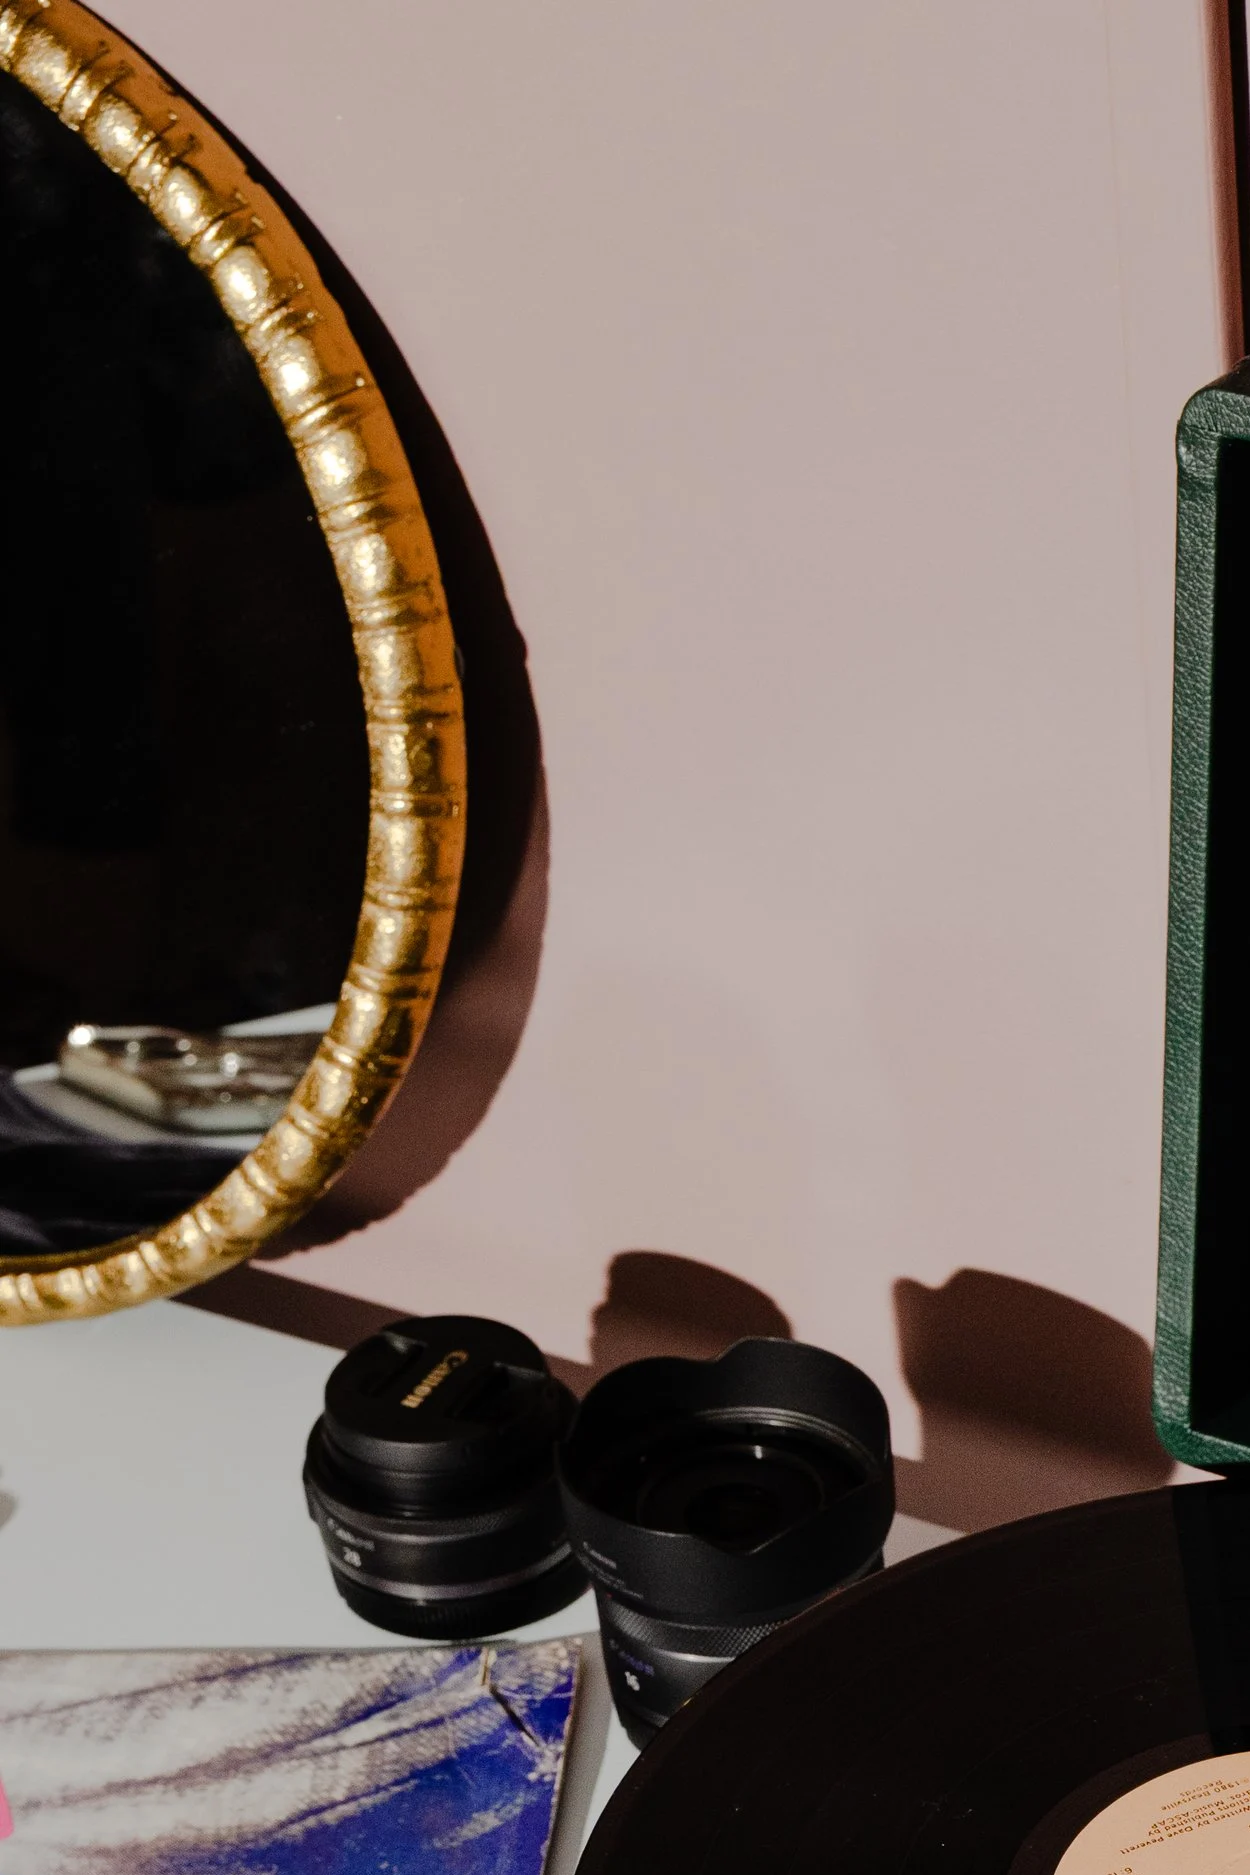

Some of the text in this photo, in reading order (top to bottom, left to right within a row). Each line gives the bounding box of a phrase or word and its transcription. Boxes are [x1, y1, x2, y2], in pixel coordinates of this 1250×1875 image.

[400, 1350, 469, 1409] Canon
[1178, 1779, 1223, 1798] Records
[1160, 1789, 1211, 1813] Bearsville
[1168, 1810, 1215, 1831] Published
[1212, 1804, 1250, 1822] Written
[1147, 1825, 1164, 1837] by
[1167, 1824, 1193, 1839] Dave
[1195, 1818, 1210, 1828] by
[1119, 1836, 1164, 1856] Peverett
